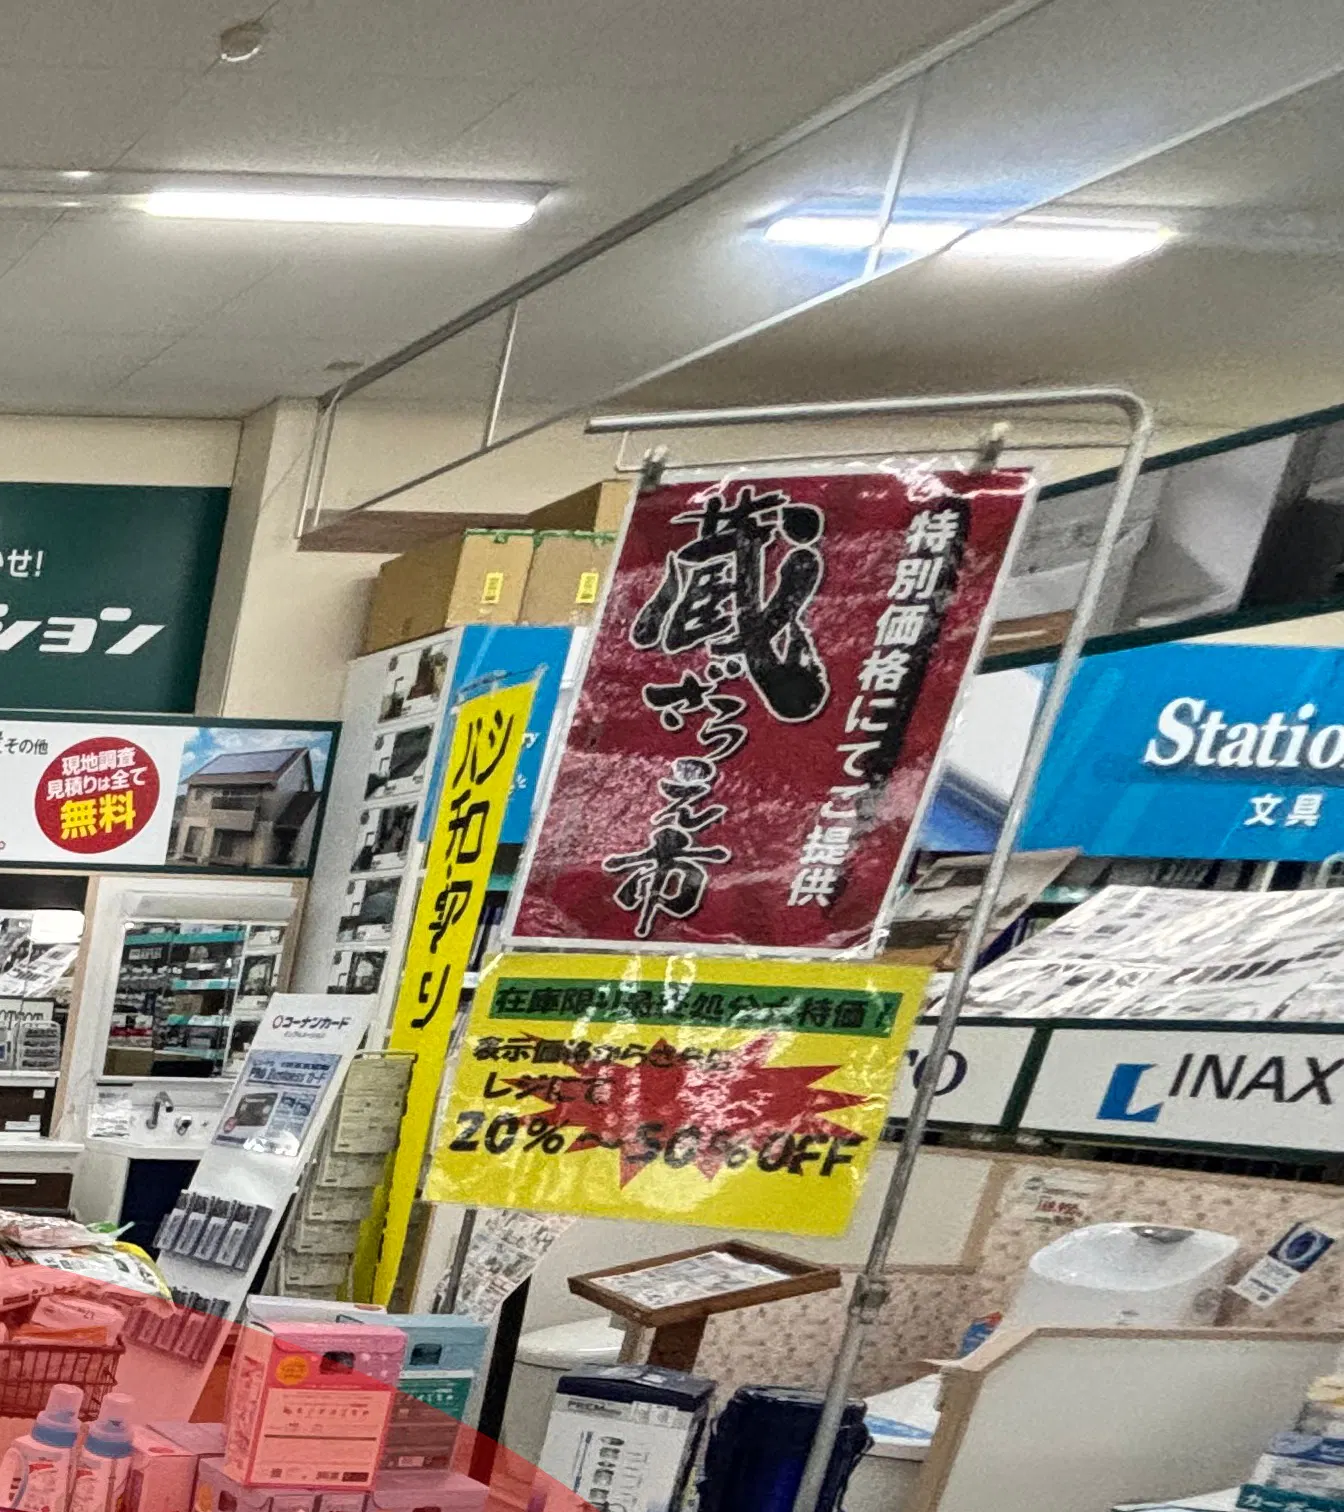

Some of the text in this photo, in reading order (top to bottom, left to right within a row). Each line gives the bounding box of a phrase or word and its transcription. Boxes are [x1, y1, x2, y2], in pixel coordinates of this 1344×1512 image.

[787, 508, 958, 908] 特別価格にてご提供
[1145, 697, 1344, 770] Statio
[45, 766, 149, 801] 見積りは全て
[60, 746, 137, 777] 現地調査
[59, 790, 137, 841] 無料
[1244, 793, 1325, 828] 文具
[1168, 1052, 1344, 1106] INAX
